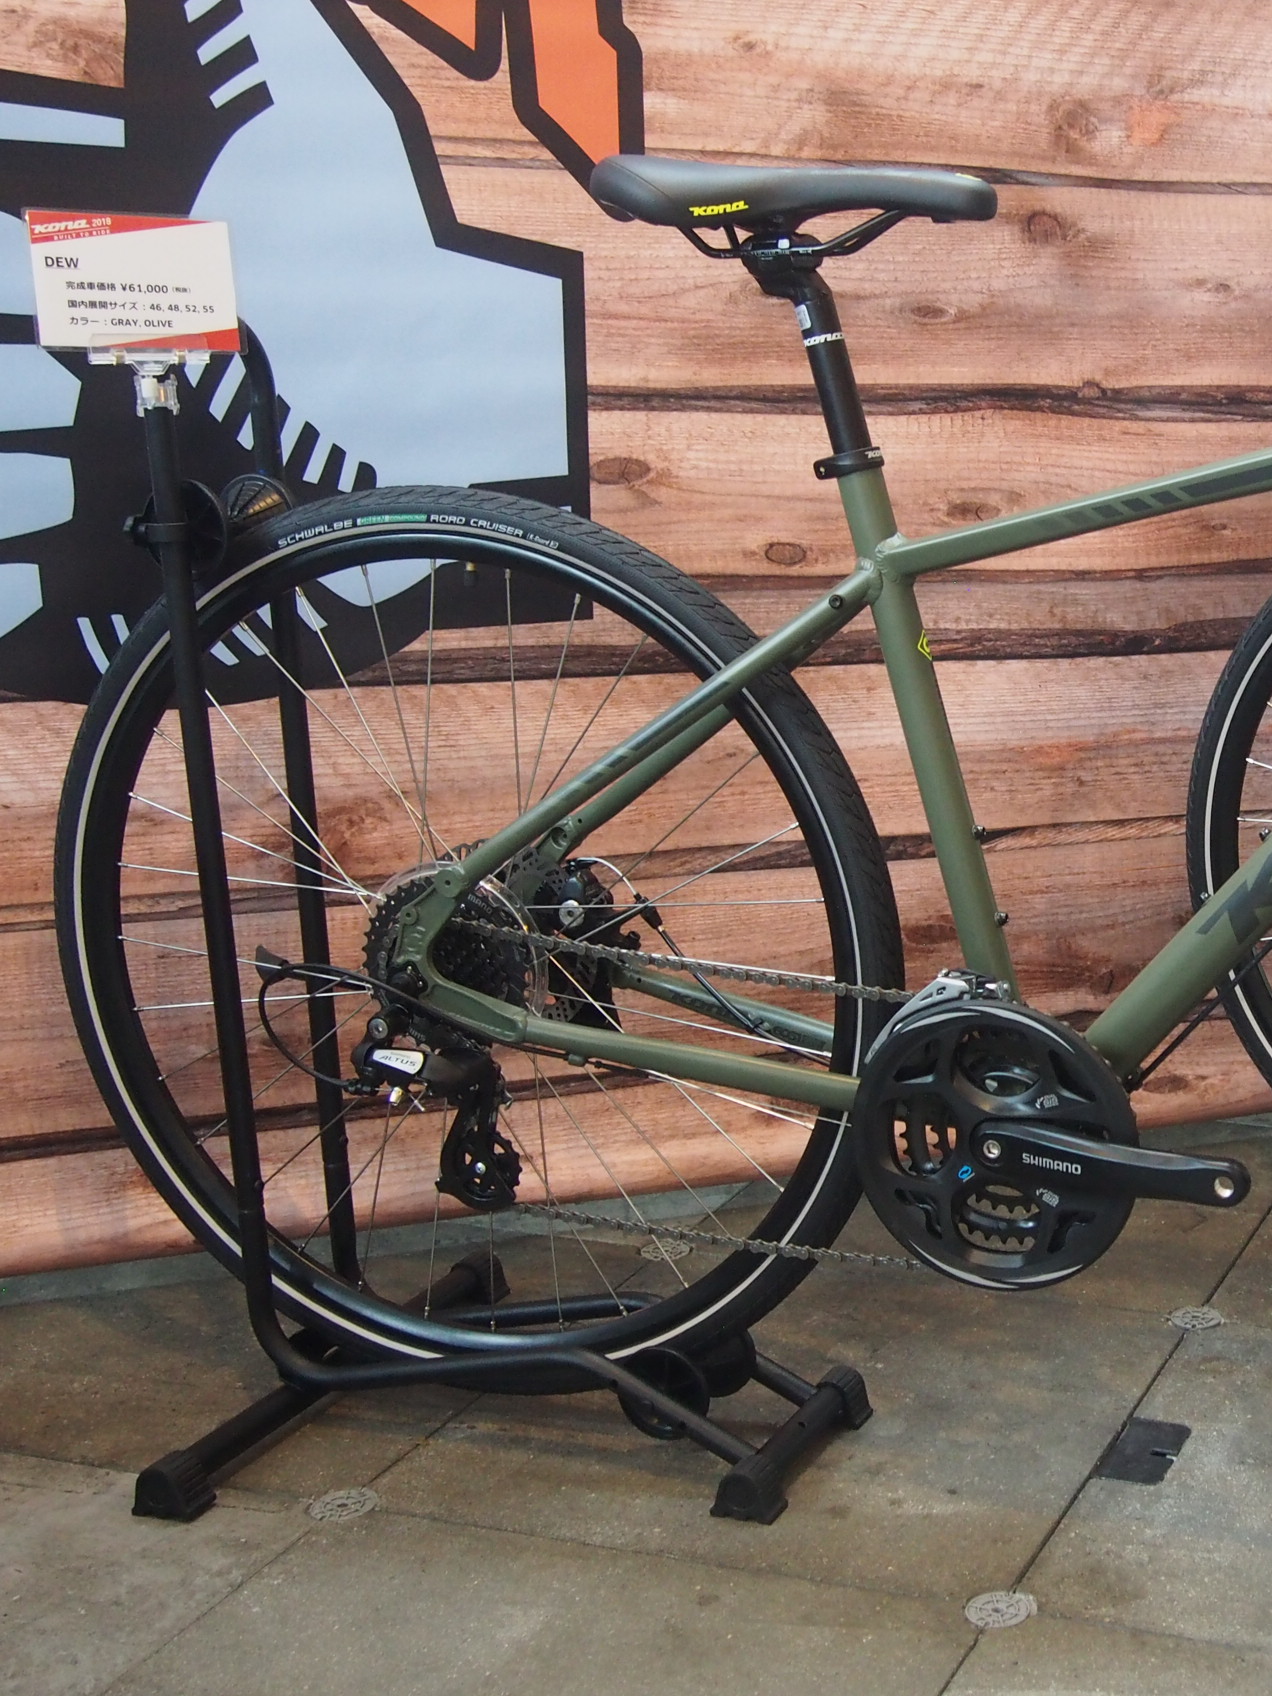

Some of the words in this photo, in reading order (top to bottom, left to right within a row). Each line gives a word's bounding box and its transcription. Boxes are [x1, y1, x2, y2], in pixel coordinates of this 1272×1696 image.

[44, 256, 79, 269] DEW
[144, 319, 173, 328] OLIVE
[278, 519, 353, 549] SCHWALBE
[430, 513, 466, 525] ROAD
[469, 517, 524, 538] CRUISER
[380, 1055, 417, 1067] ALTUS
[1022, 1152, 1082, 1175] SHIMANO
